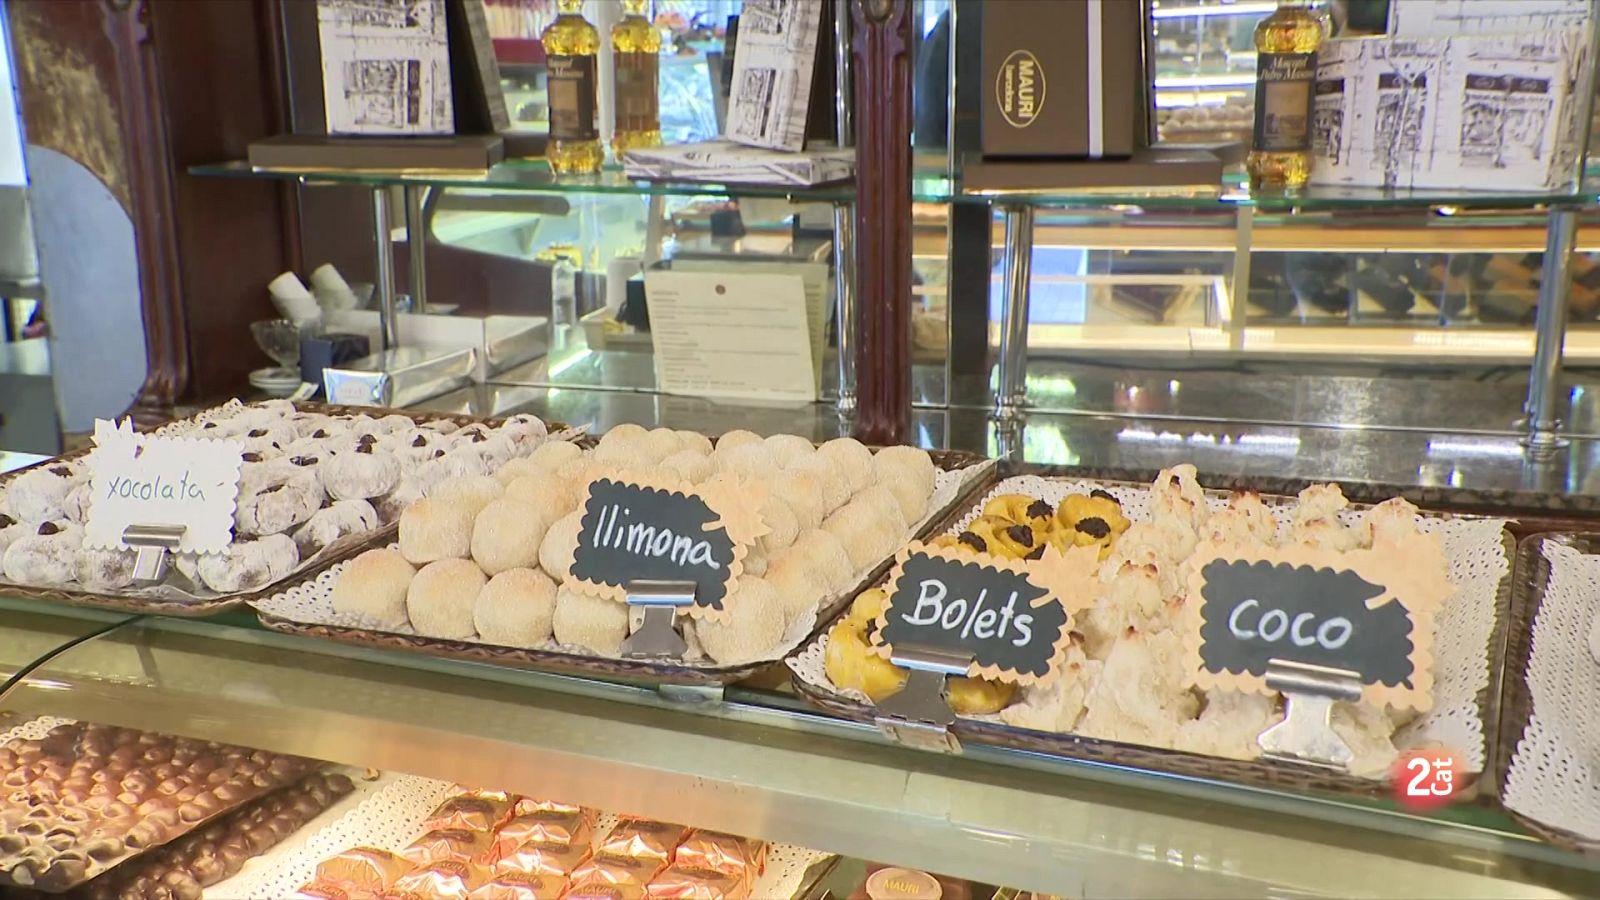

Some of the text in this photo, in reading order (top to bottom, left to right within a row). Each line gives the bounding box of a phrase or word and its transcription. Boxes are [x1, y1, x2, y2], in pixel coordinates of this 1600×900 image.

[1019, 60, 1034, 117] MAURI
[107, 470, 205, 501] xocolata
[593, 504, 720, 570] llimona
[901, 579, 1034, 646] Bolets
[883, 879, 920, 895] MAURI
